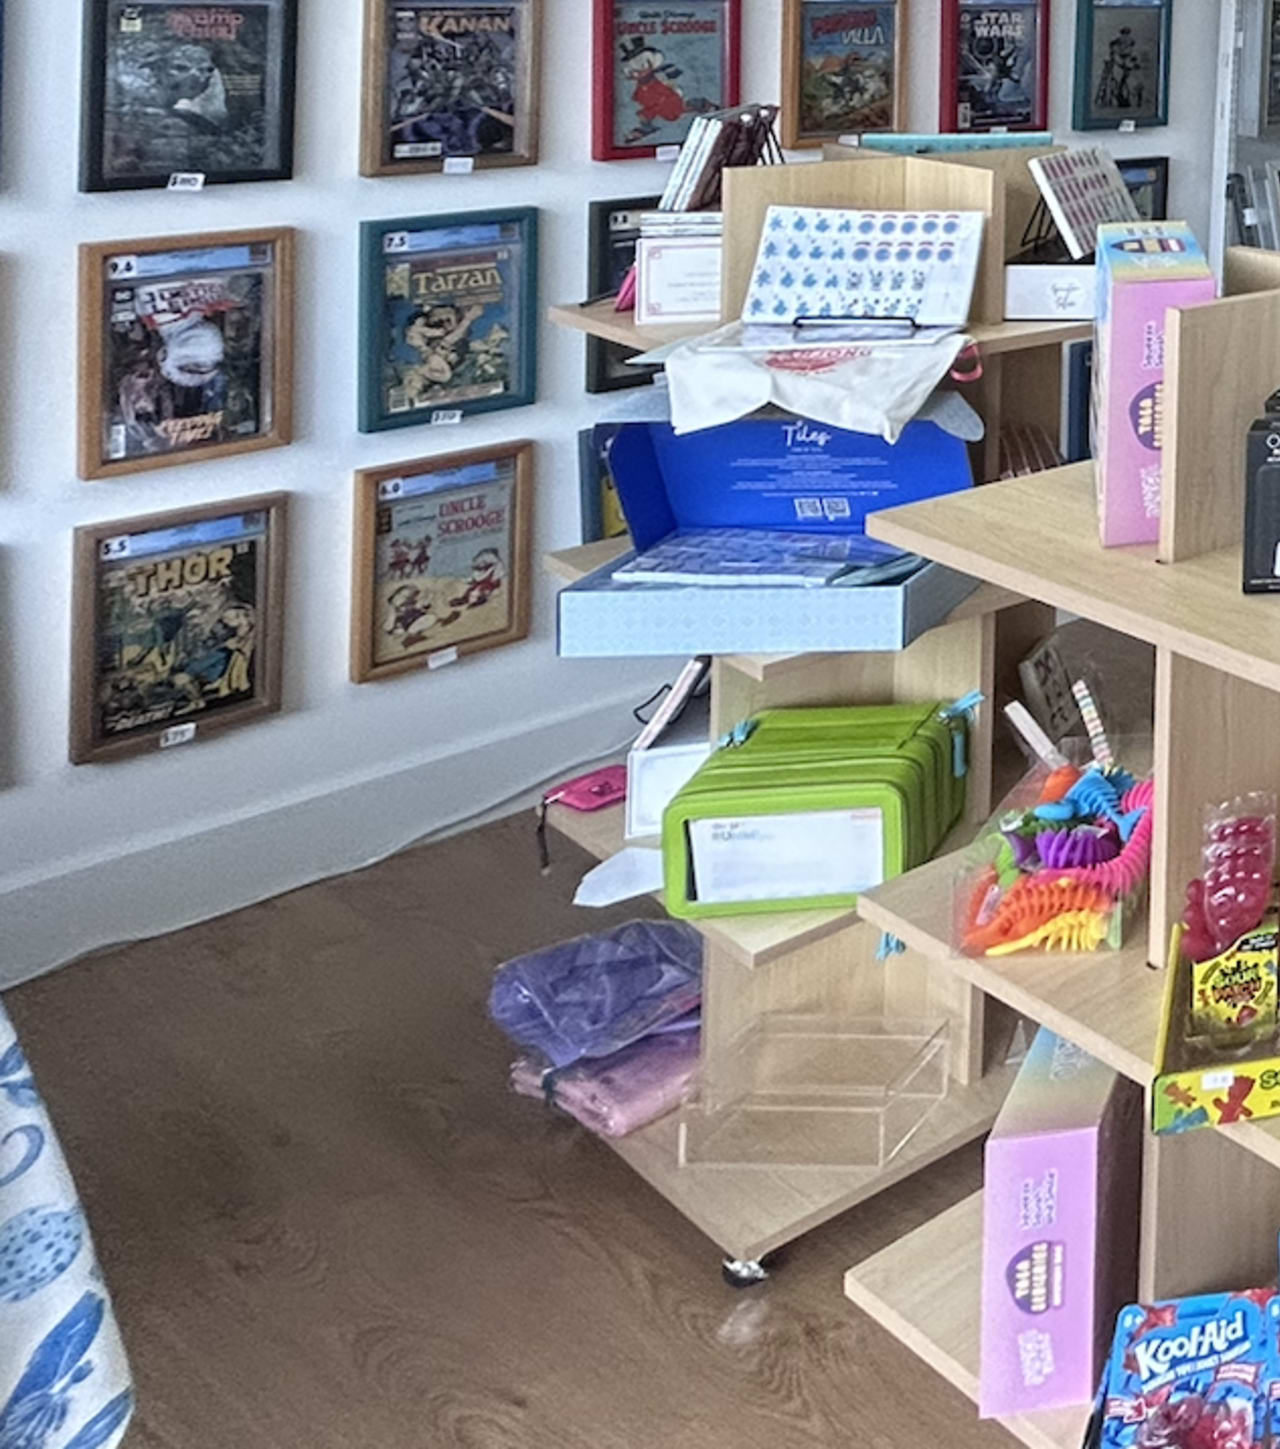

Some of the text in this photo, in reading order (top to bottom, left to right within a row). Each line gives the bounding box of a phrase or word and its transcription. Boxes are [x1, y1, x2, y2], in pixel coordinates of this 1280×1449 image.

[419, 14, 511, 34] KANAN
[979, 12, 1023, 24] STAR
[974, 25, 1025, 37] WARS
[412, 267, 503, 295] Tarzan
[782, 421, 832, 446] Tiles
[438, 495, 487, 518] UNCLE
[437, 508, 505, 535] SCROOGE
[131, 548, 235, 596] THOR
[1135, 1310, 1244, 1380] Kool-Aid
